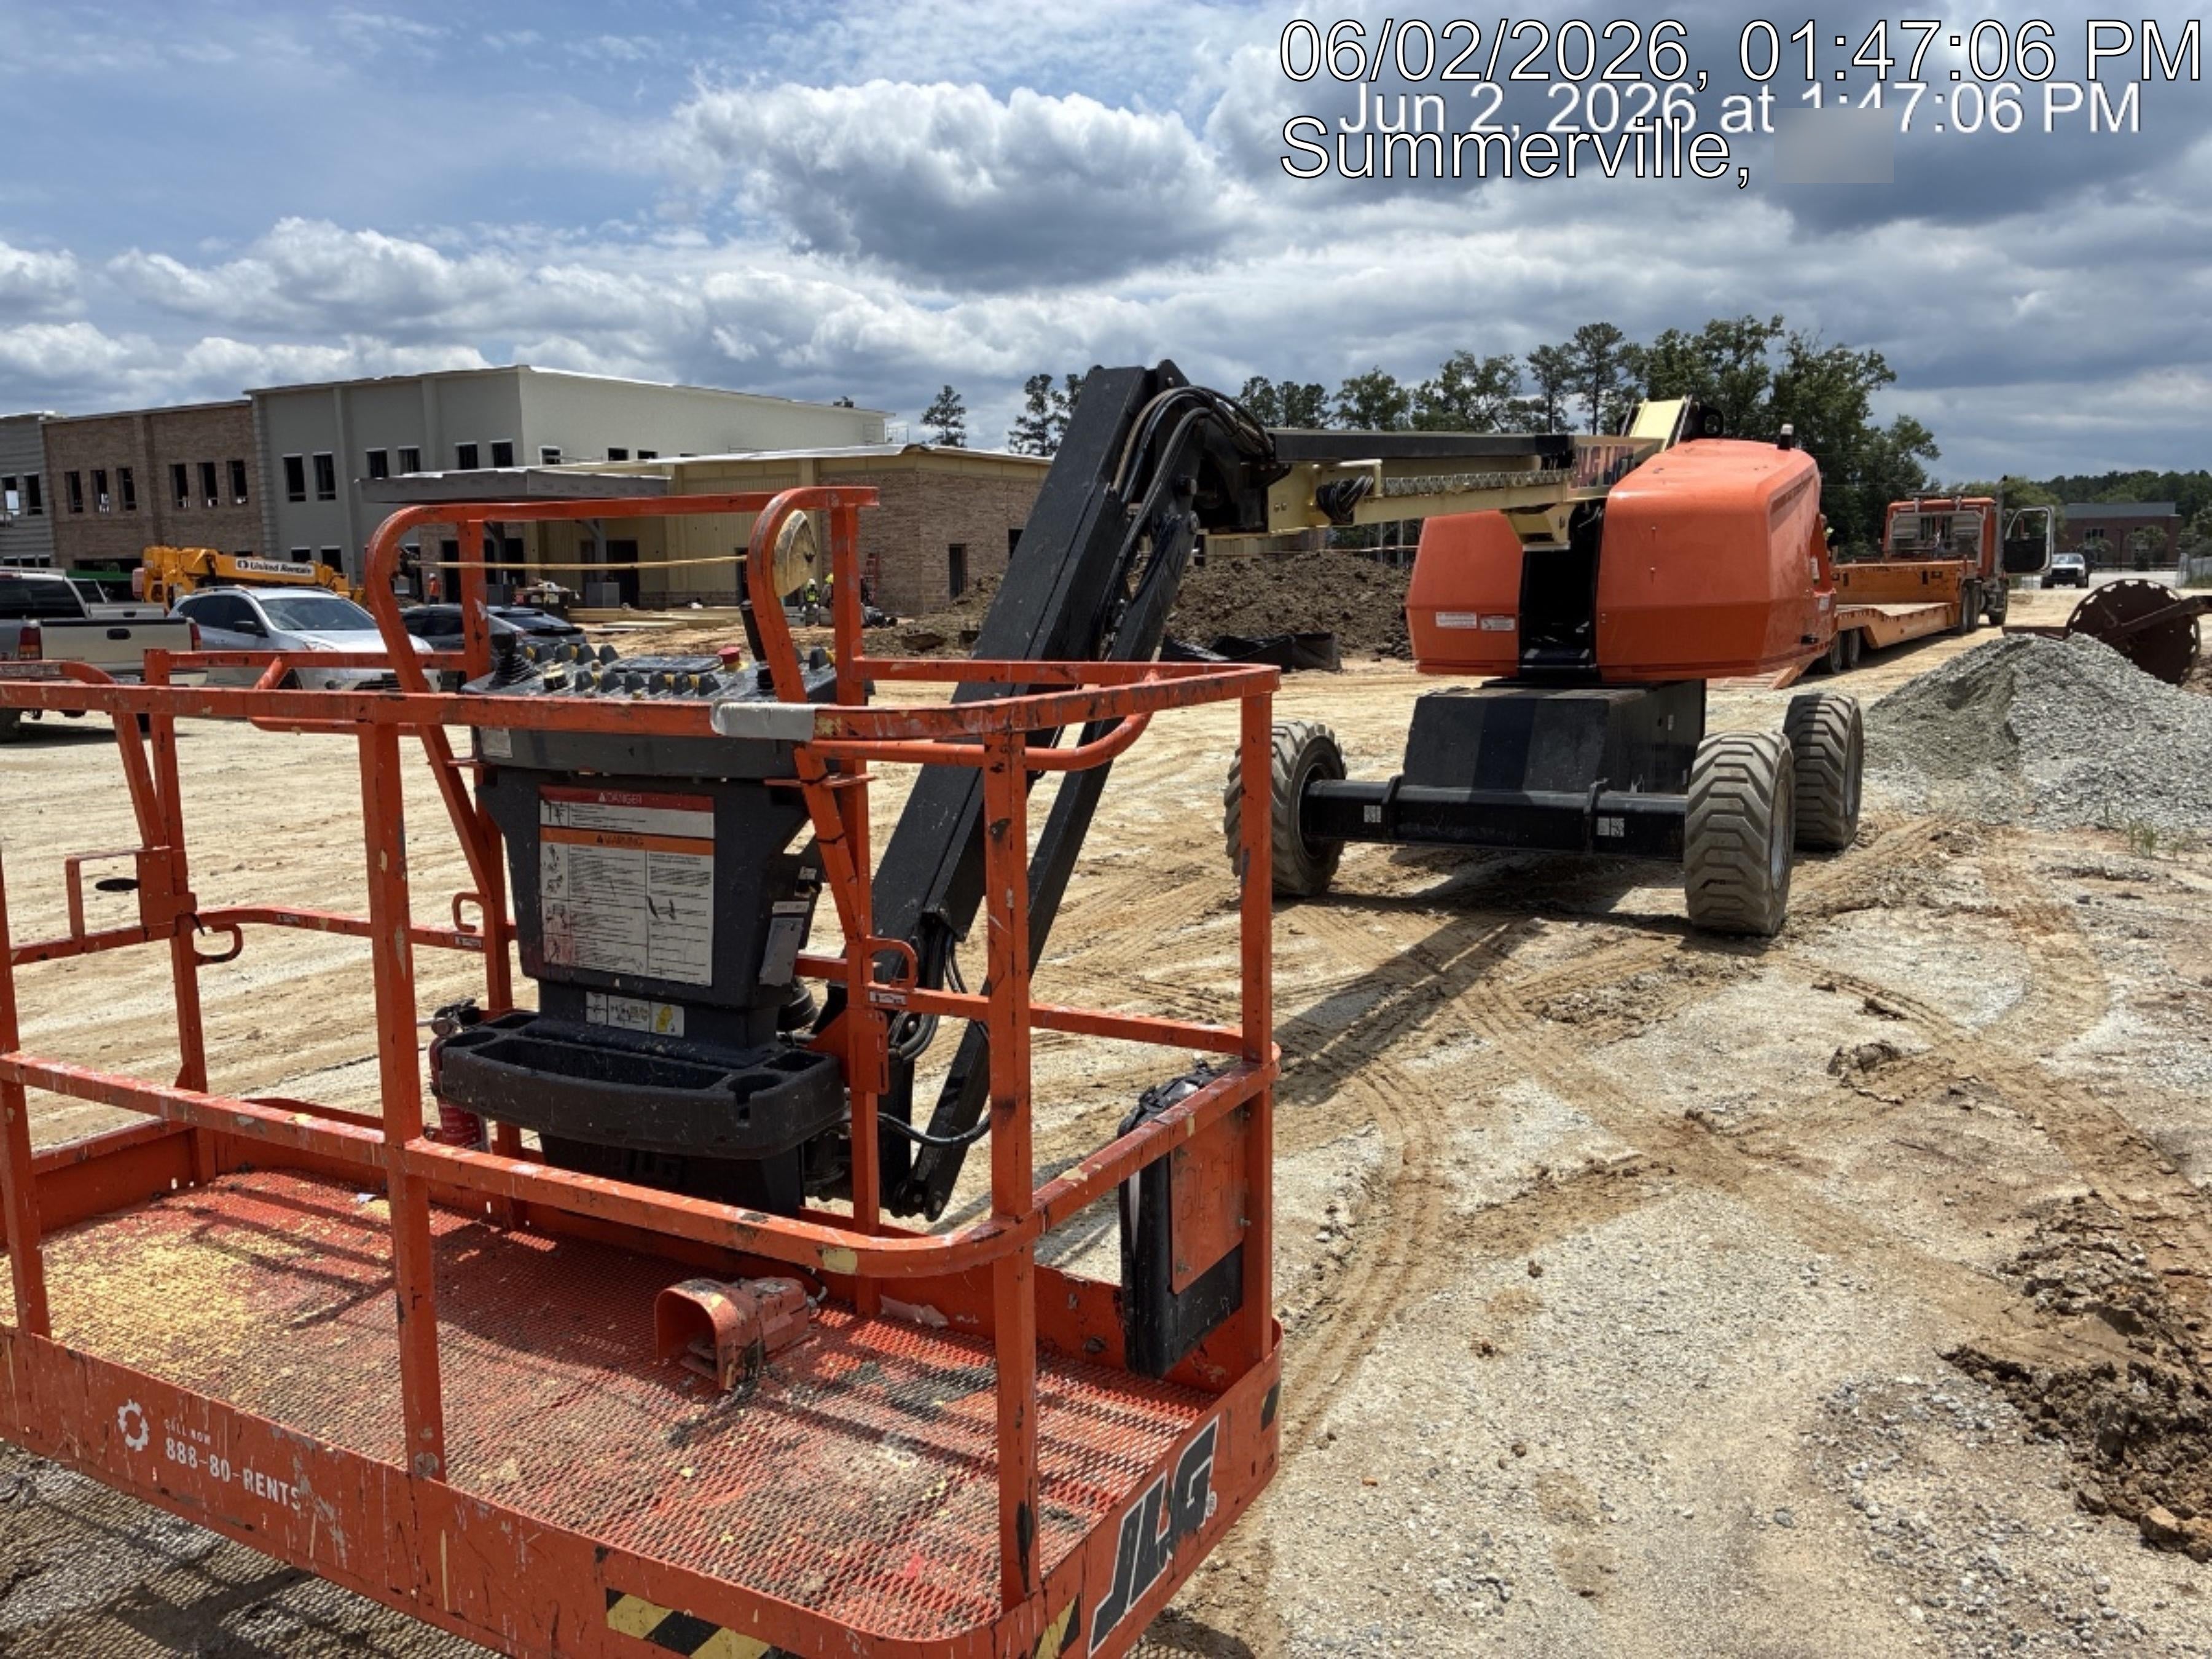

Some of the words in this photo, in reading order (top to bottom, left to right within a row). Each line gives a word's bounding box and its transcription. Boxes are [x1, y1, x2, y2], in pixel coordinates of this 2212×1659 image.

[251, 562, 279, 571] United
[606, 793, 642, 804] DANGER
[166, 1437, 301, 1510] 888-80-RENTS
[1088, 1414, 1219, 1658] JLG
